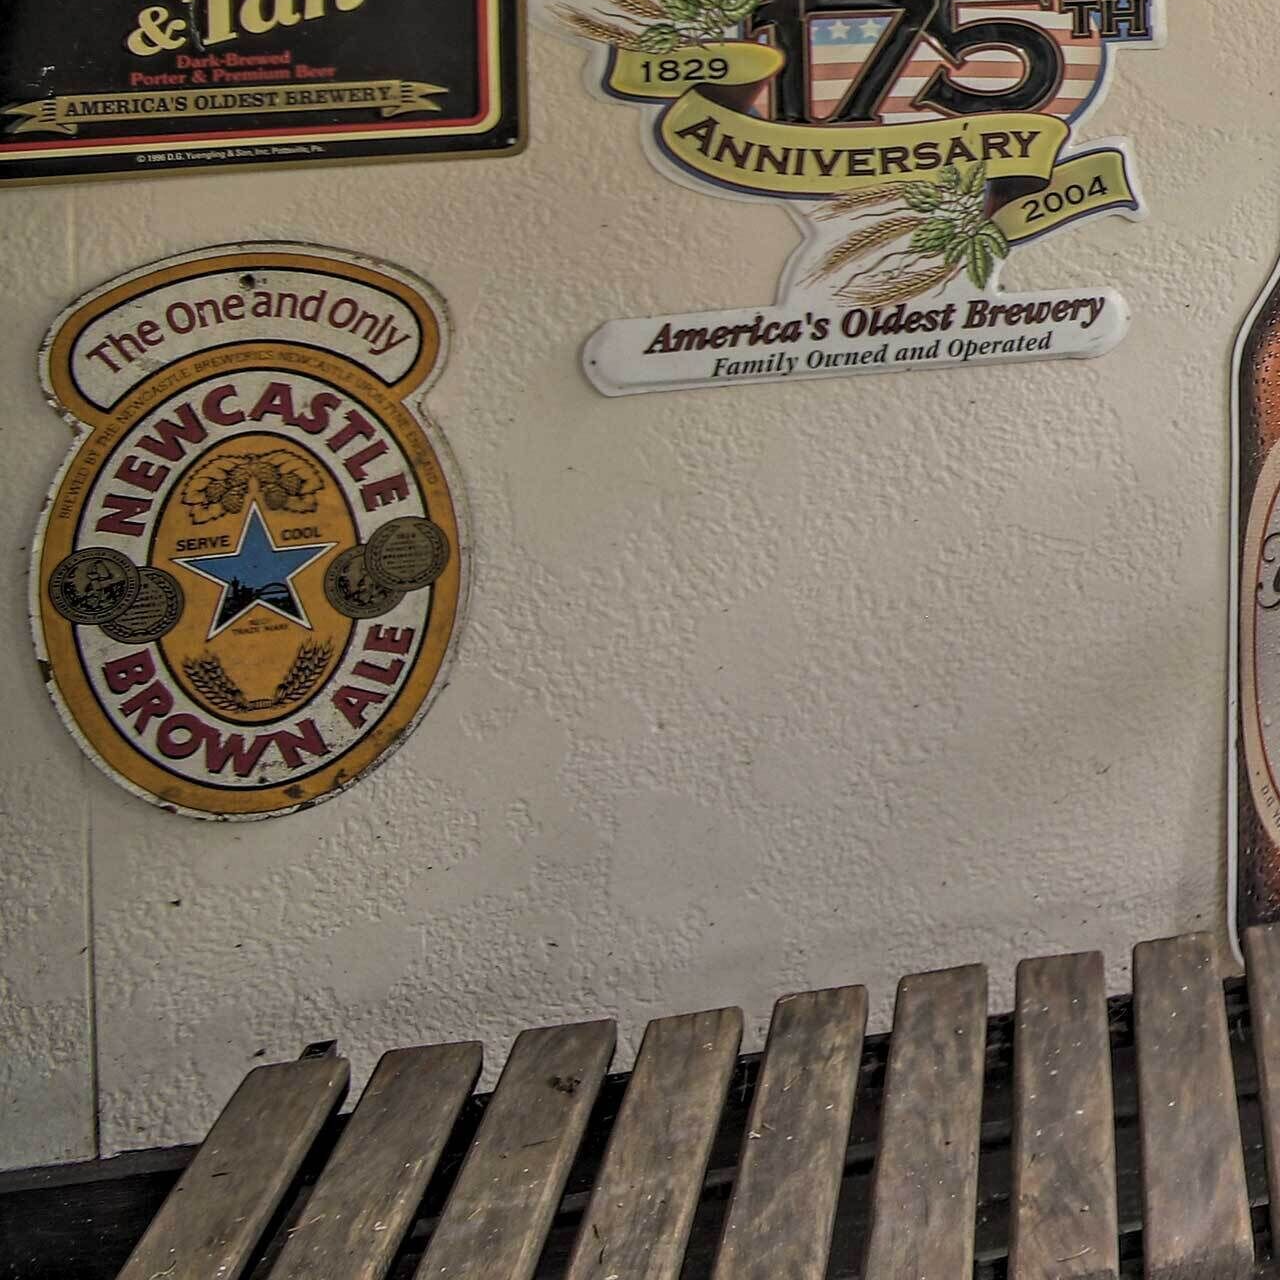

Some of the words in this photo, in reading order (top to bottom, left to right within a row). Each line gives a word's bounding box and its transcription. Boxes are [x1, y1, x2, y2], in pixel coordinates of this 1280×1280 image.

[126, 6, 188, 56] &
[130, 71, 187, 87] Porter
[191, 70, 207, 84] &
[213, 67, 290, 83] Premium
[295, 64, 337, 79] Beer
[176, 51, 291, 69] Dark-Brewed
[641, 58, 729, 85] 1829
[64, 95, 188, 117] AMERICA'S
[194, 92, 278, 111] OLDEST
[676, 117, 1041, 177] ANNIVERSARY
[1020, 173, 1109, 222] 2004
[86, 319, 165, 373] The
[166, 293, 245, 334] One
[251, 289, 328, 322] and
[329, 297, 412, 356] Only
[643, 313, 829, 355] America's
[843, 304, 954, 339] Oldest
[964, 295, 1106, 331] Brewery
[710, 353, 798, 379] Family
[807, 347, 888, 370] Owned
[894, 341, 940, 363] and
[948, 331, 1053, 361] Operated
[94, 381, 411, 537] NEWCASTLE
[176, 535, 231, 552] SERVE
[281, 527, 323, 541] COOL
[102, 648, 333, 777] BROWN
[328, 624, 415, 729] ALE
